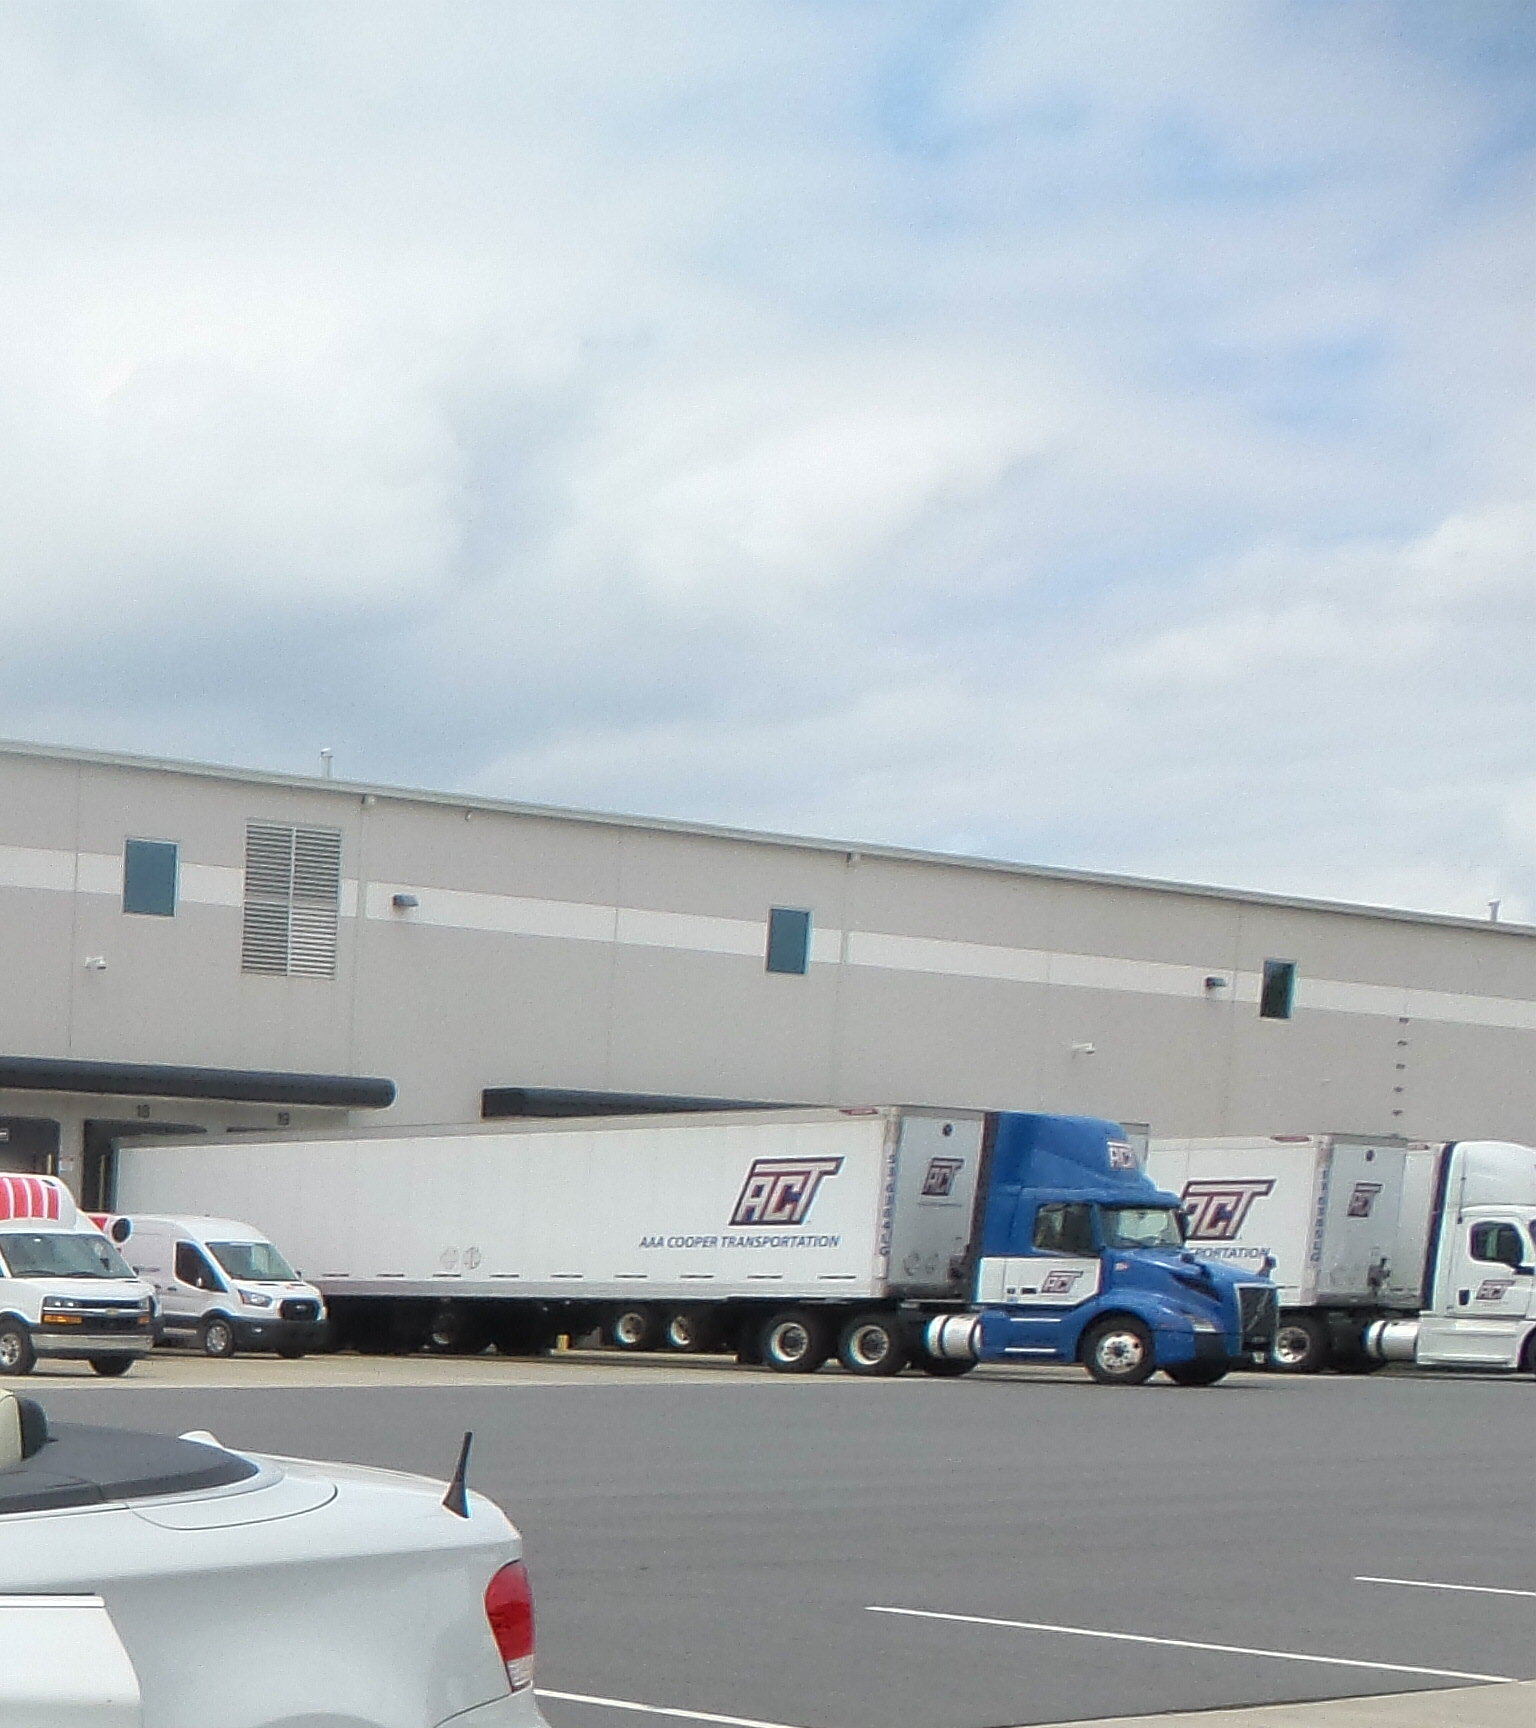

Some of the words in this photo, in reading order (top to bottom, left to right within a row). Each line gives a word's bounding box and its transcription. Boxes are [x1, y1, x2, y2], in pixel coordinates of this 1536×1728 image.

[729, 1156, 845, 1226] ACT
[638, 1236, 664, 1248] AAA
[667, 1236, 717, 1248] COOPER
[721, 1235, 841, 1248] TRANSPORTATION
